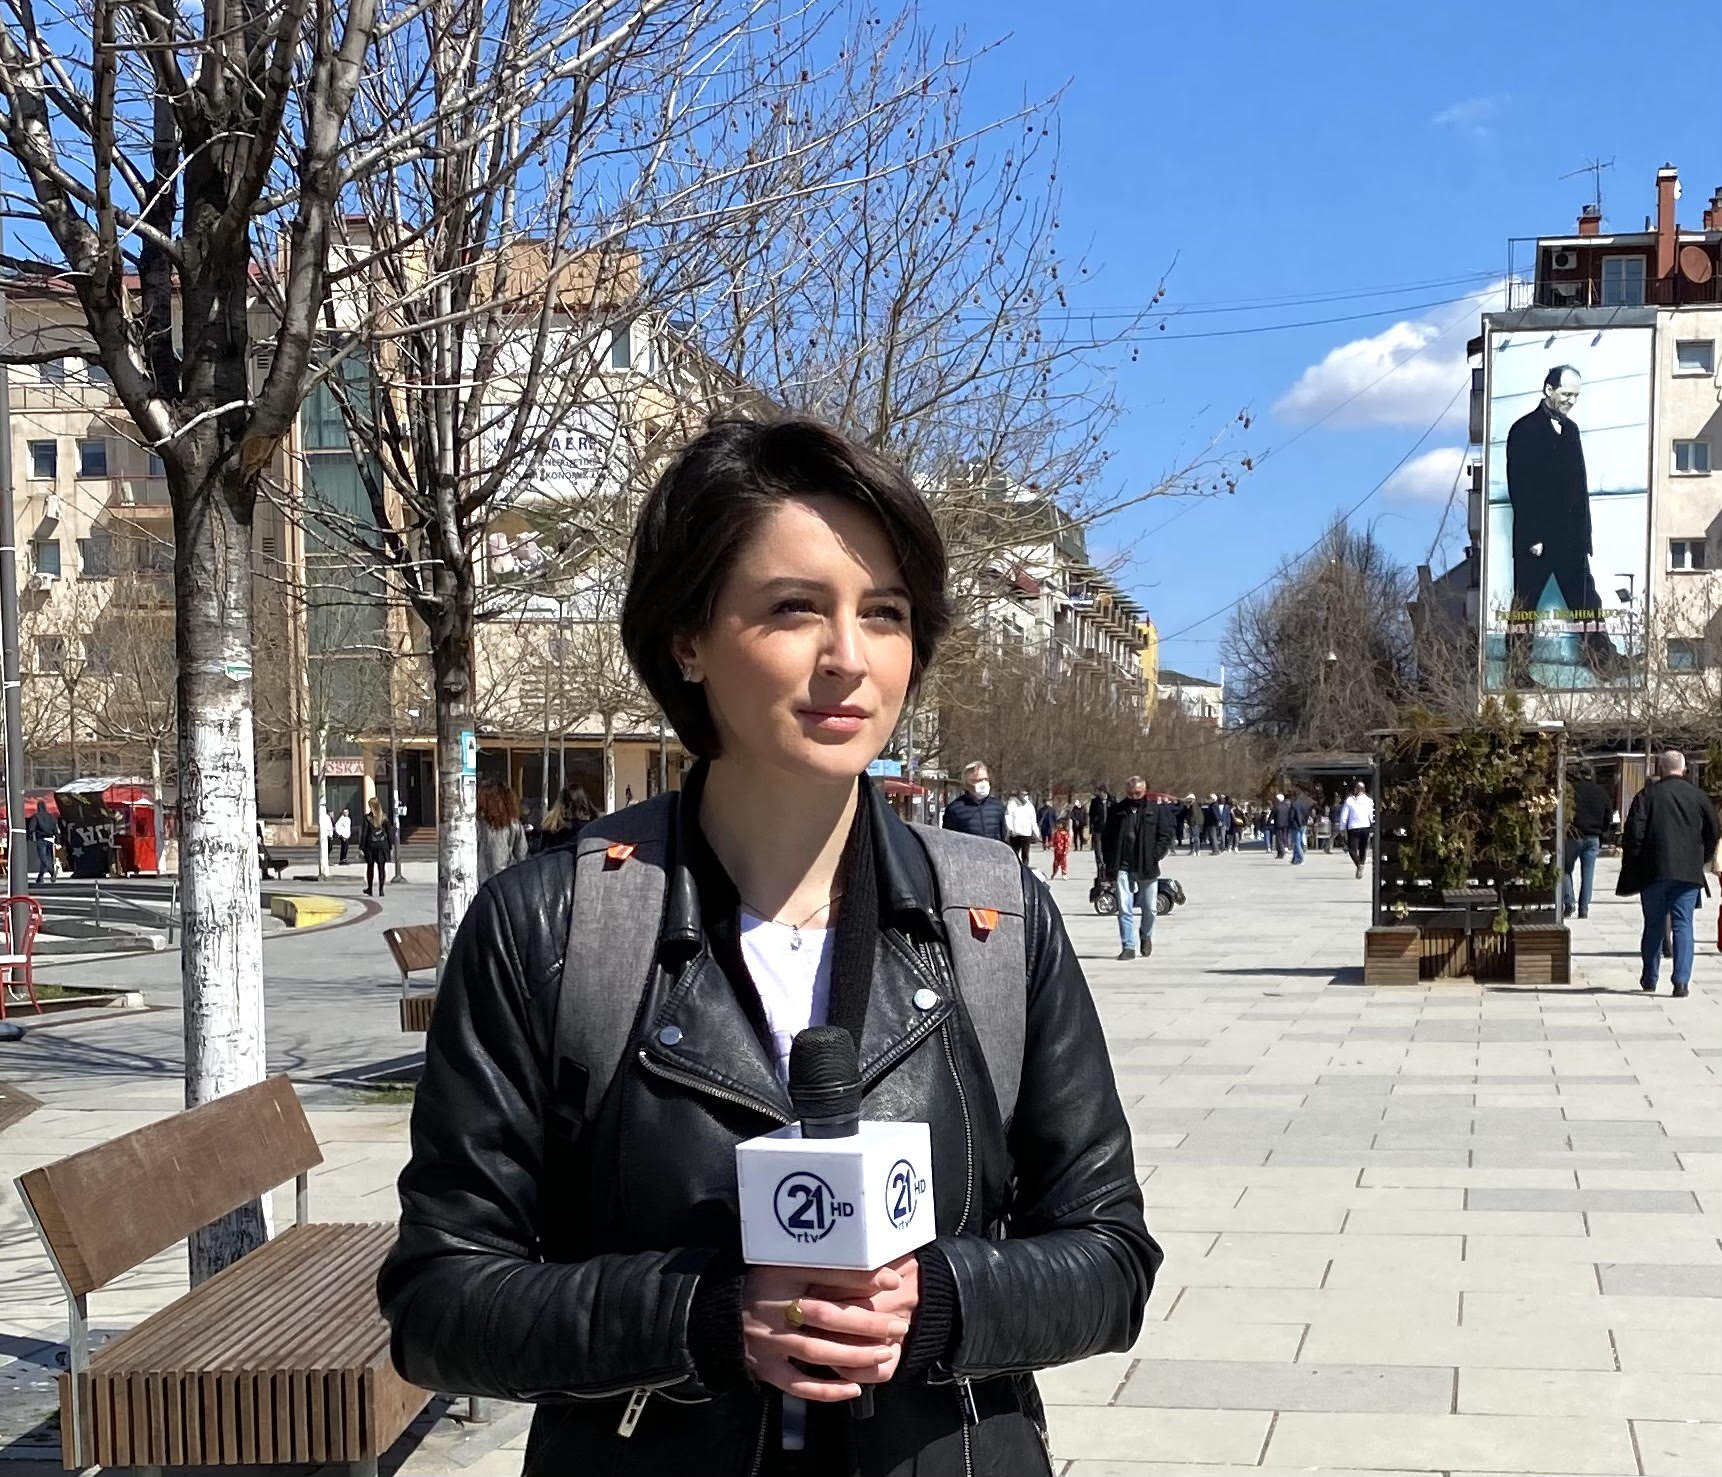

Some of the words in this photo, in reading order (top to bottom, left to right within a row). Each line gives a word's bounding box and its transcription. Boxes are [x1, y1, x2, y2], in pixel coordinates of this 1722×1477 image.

[787, 1184, 825, 1230] 21
[830, 1202, 854, 1217] HD
[892, 1168, 912, 1220] 21
[914, 1179, 927, 1195] HD
[796, 1231, 820, 1243] rtv
